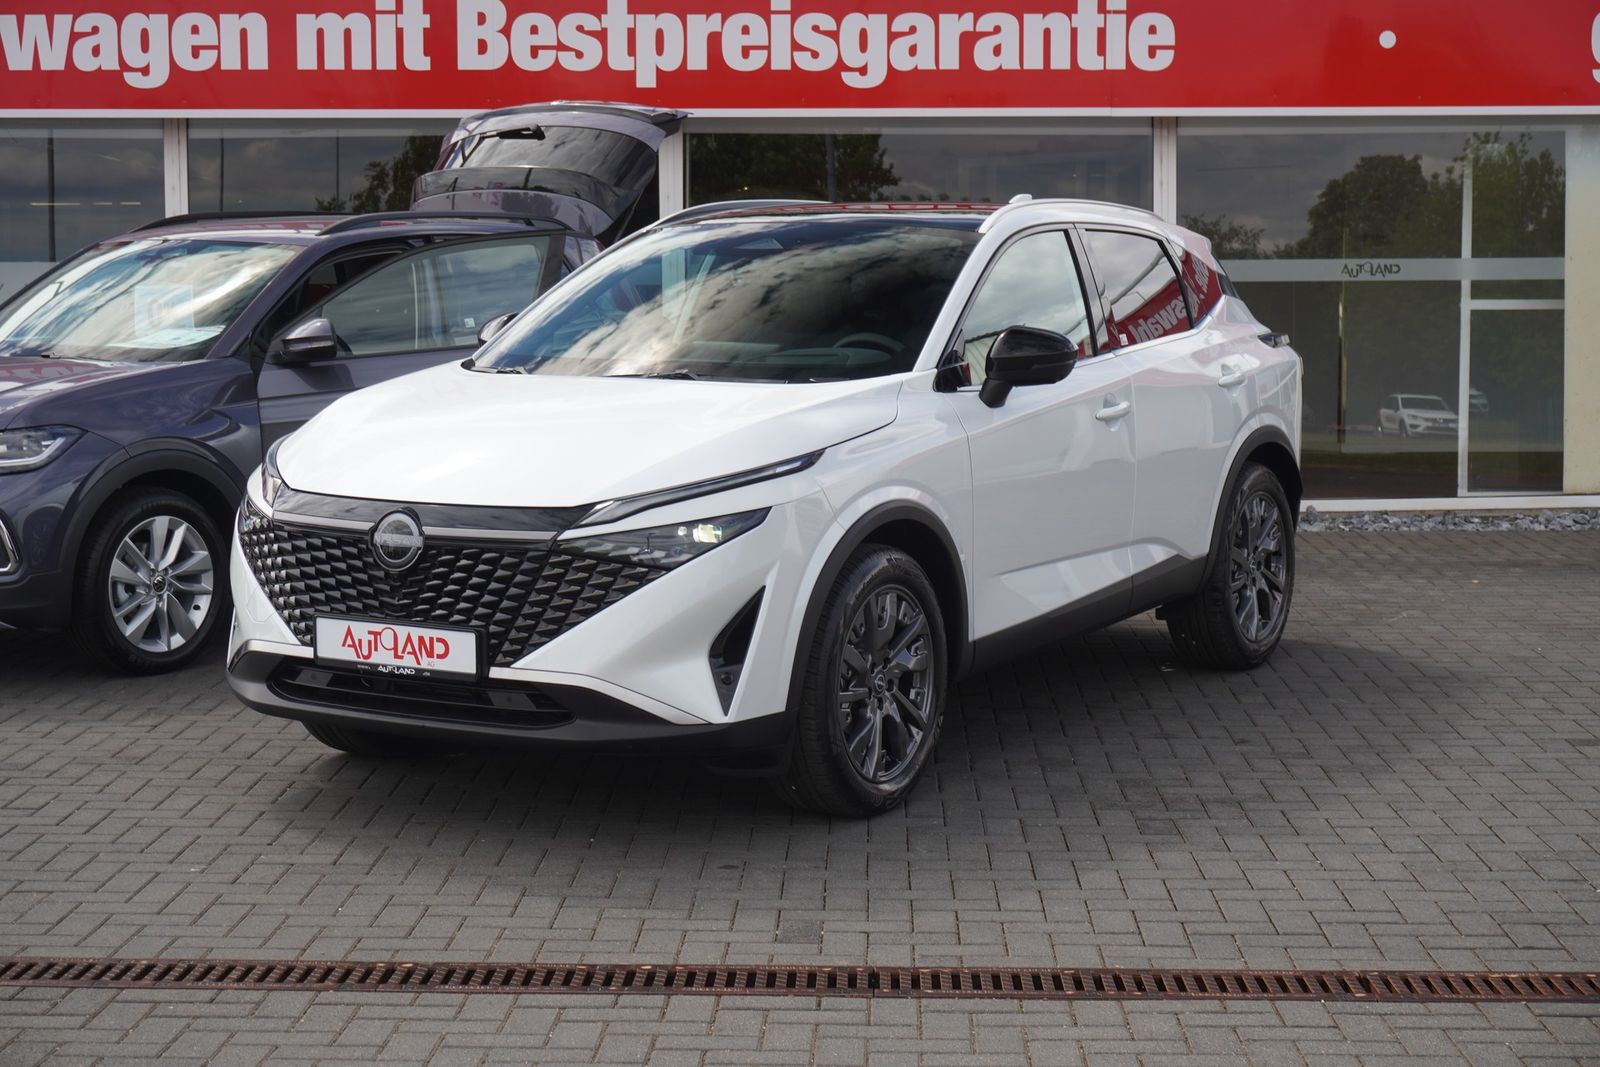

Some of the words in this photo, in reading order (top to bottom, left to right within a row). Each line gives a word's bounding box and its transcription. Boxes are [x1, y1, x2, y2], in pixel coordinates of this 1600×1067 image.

[0, 12, 268, 88] wagen
[296, 0, 431, 71] mit
[457, 0, 1175, 88] Bestpreisgarantie
